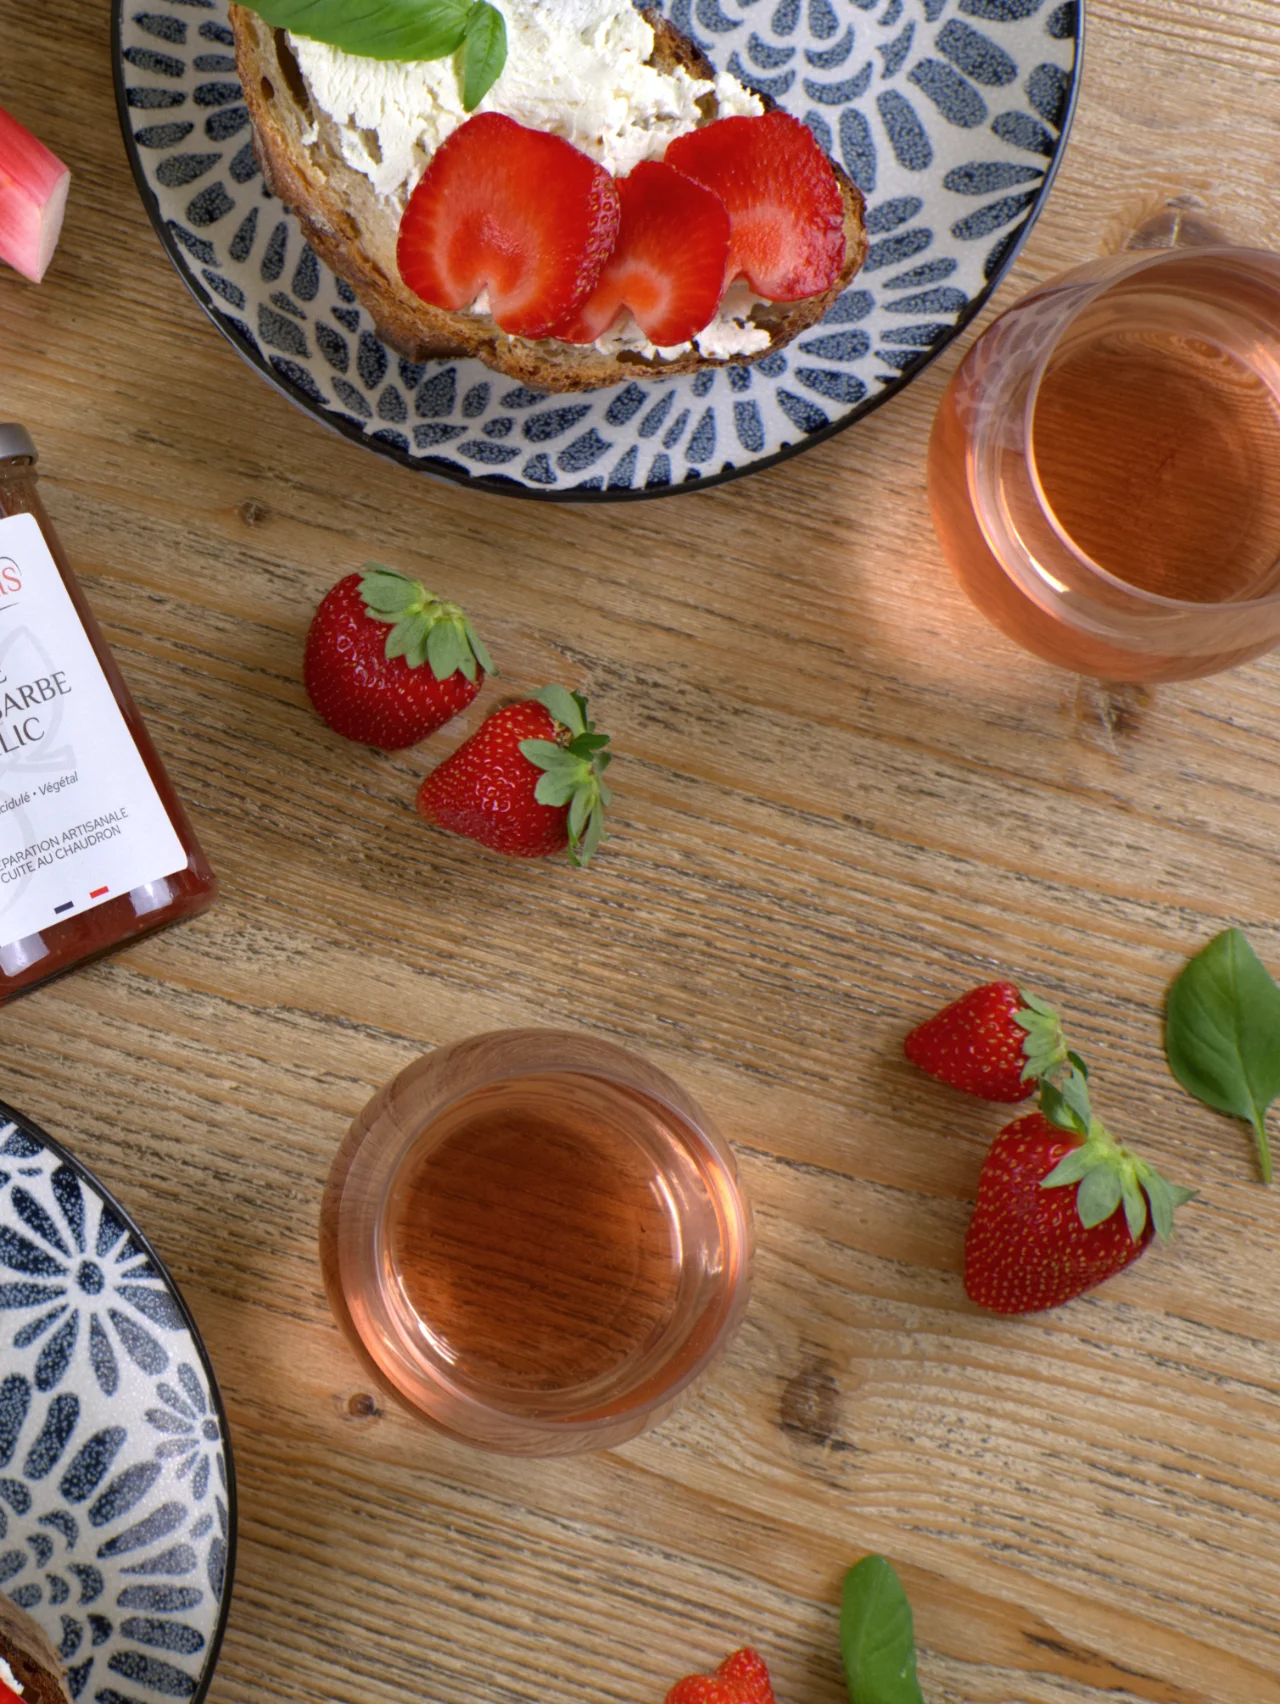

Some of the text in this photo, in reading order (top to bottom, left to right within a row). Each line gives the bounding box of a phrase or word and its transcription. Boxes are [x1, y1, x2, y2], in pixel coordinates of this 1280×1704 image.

[38, 772, 79, 796] Végétal
[61, 808, 129, 843] ARTISANALE
[0, 825, 122, 884] CUITE AU CHAUDRON
